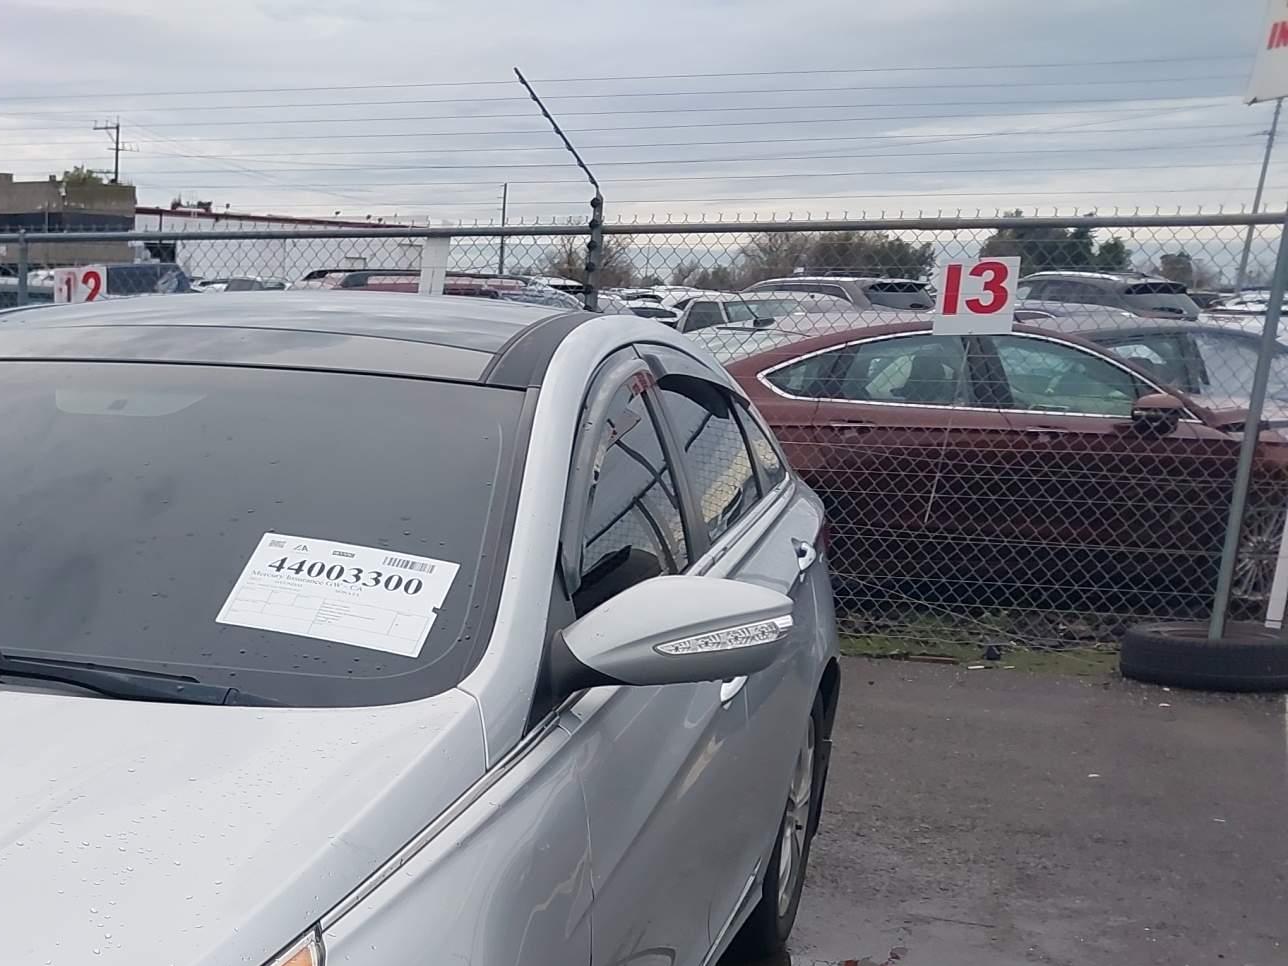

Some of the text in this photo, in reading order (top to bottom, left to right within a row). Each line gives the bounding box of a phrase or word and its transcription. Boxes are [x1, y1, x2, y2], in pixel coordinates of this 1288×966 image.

[65, 270, 102, 303] 12
[942, 261, 1009, 316] 13
[268, 556, 424, 596] 44003300
